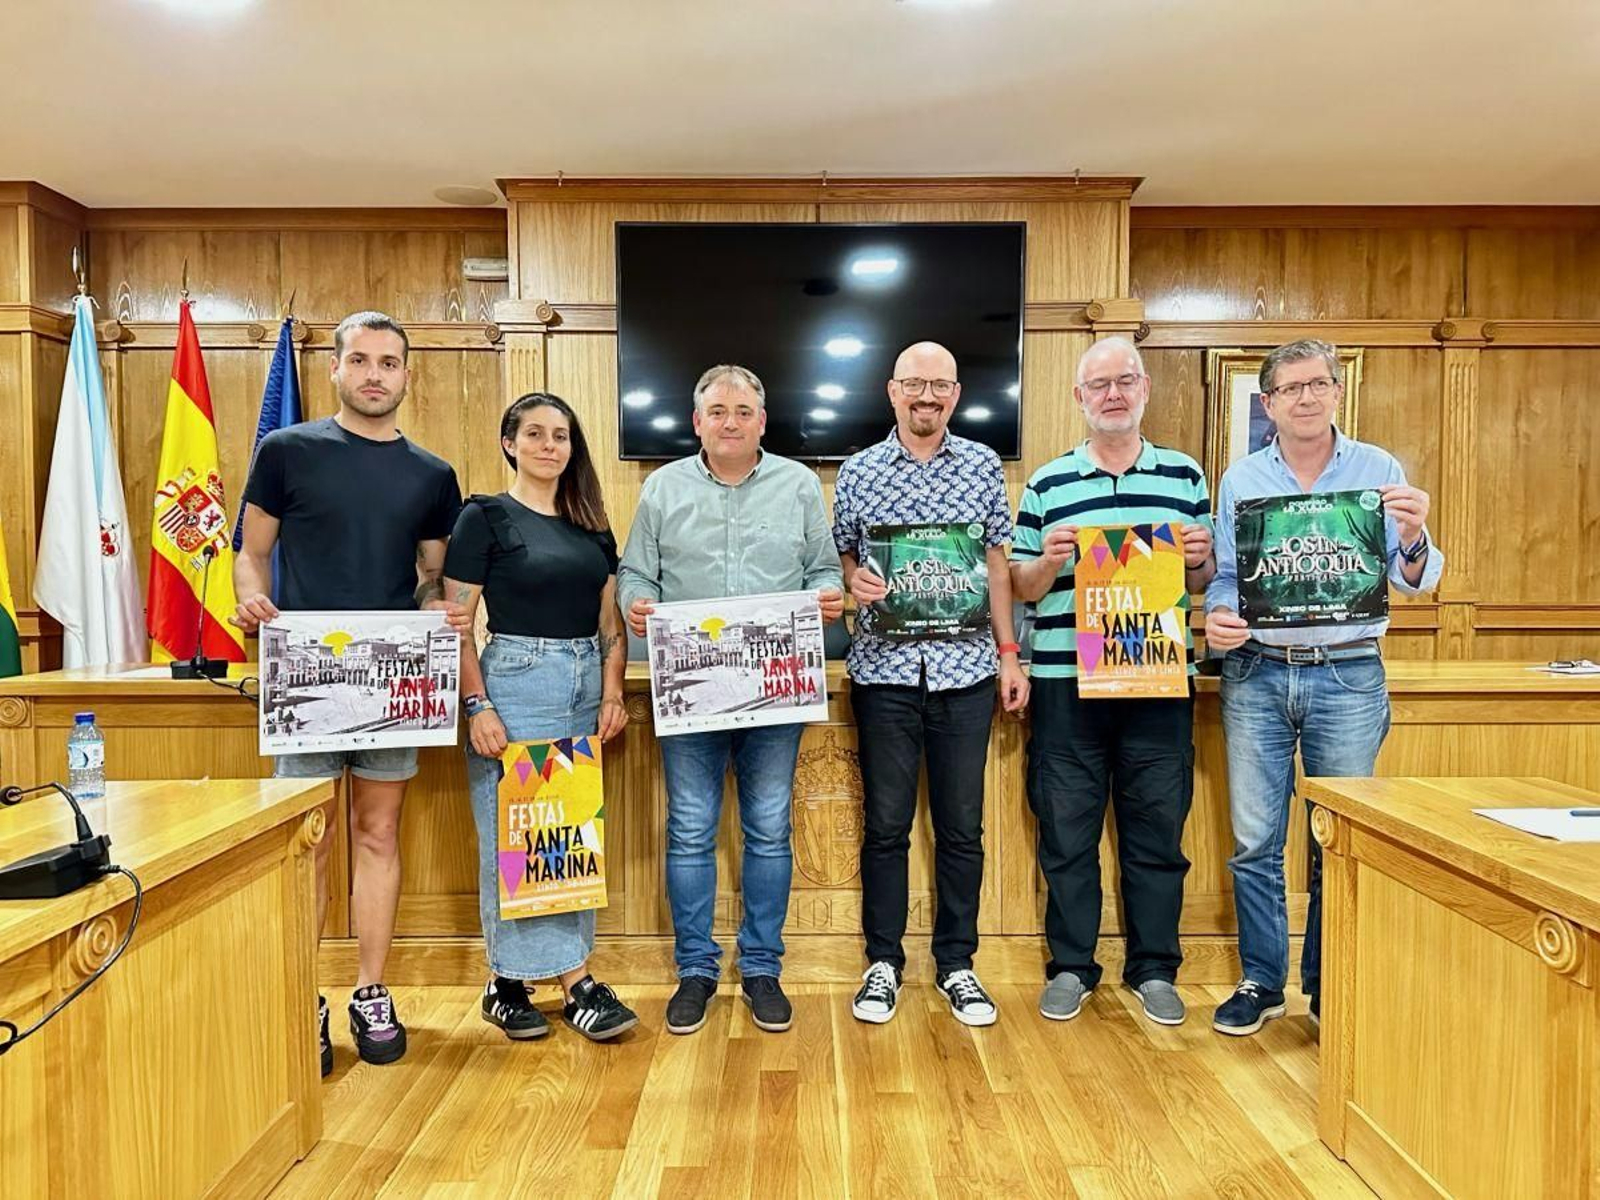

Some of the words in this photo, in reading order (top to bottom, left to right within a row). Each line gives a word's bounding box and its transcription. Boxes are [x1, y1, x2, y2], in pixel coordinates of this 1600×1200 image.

[1243, 554, 1379, 582] ANTIOQUIA
[885, 575, 981, 595] ANTIOQUIA
[1086, 586, 1144, 613] FESTAS
[1086, 613, 1099, 628] DE
[1102, 613, 1163, 639] SANTA
[750, 640, 790, 659] FESTAS
[1104, 635, 1179, 666] MARIÑA
[377, 659, 422, 678] FESTAS
[762, 657, 806, 677] SANTA
[377, 679, 389, 690] DE
[389, 677, 437, 698] SANTA
[389, 694, 447, 719] MARIÑA
[508, 801, 565, 829] FESTAS
[509, 831, 523, 845] DE
[525, 824, 583, 856] SANTA
[526, 847, 599, 884] MARIÑA
